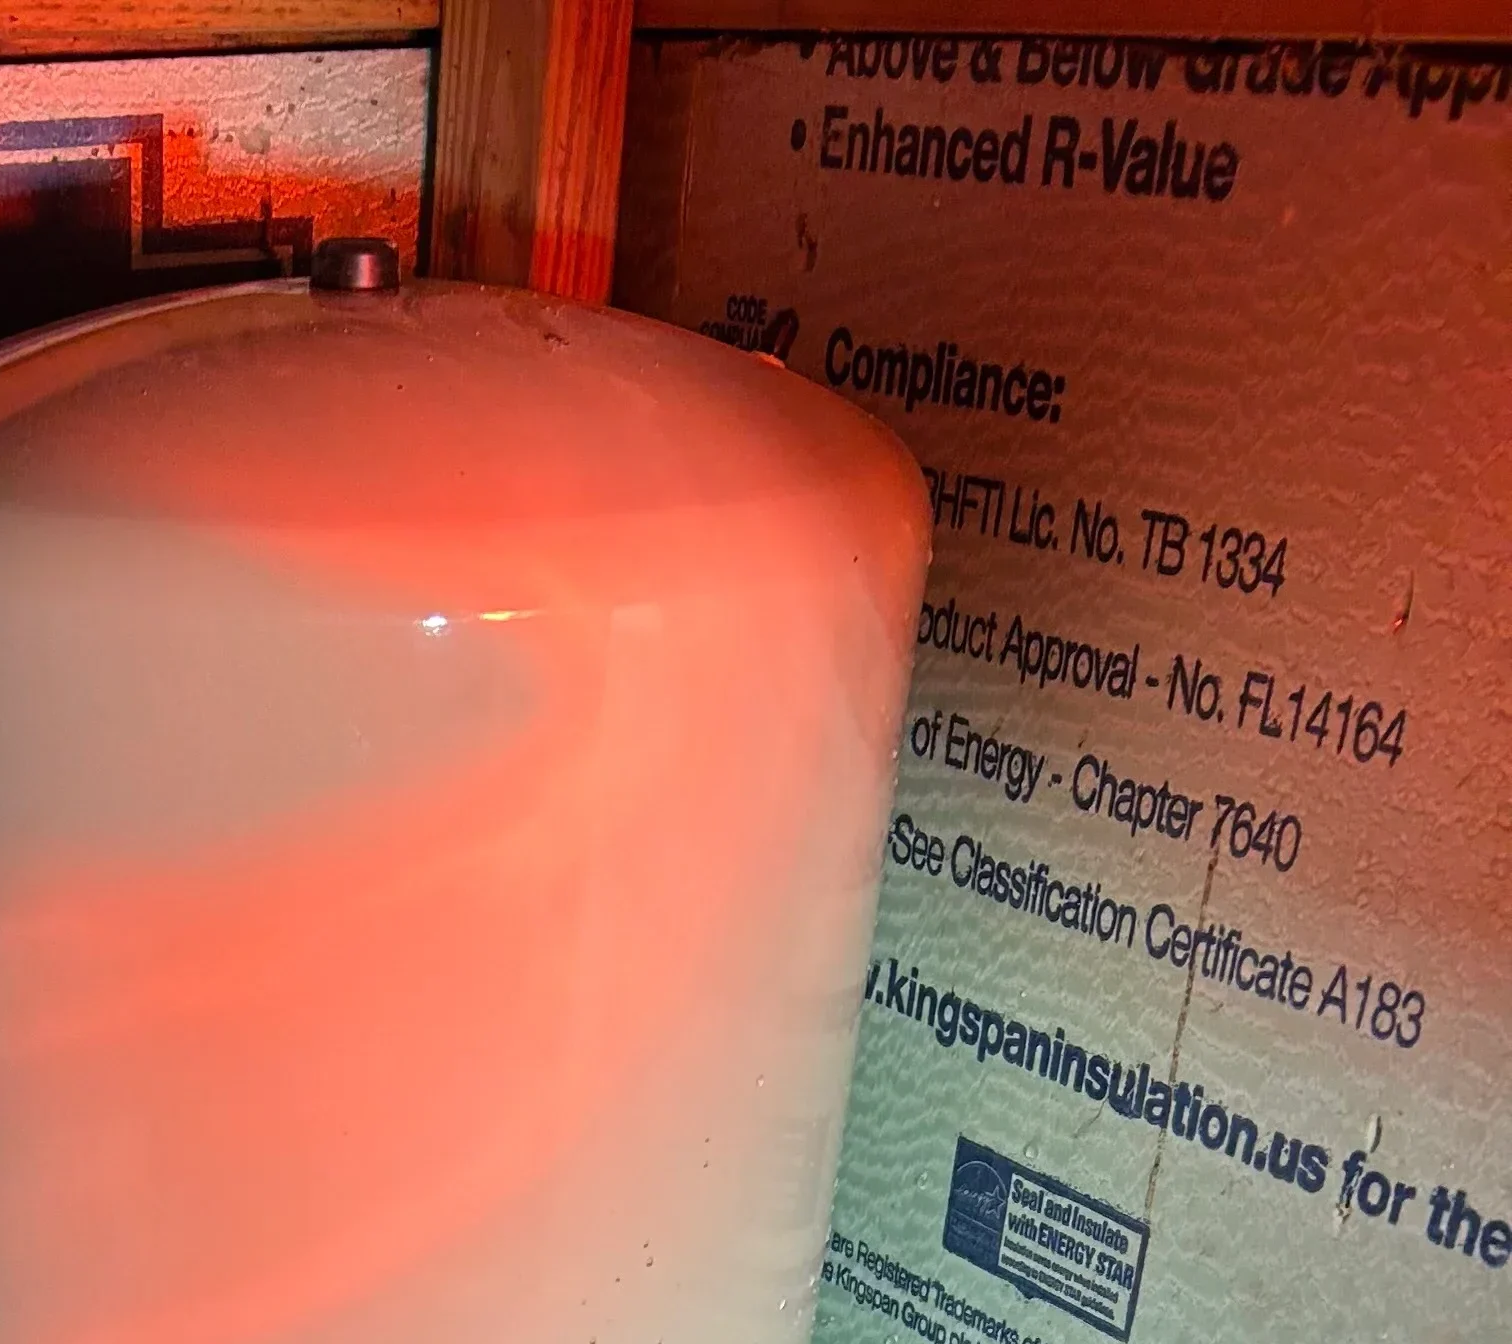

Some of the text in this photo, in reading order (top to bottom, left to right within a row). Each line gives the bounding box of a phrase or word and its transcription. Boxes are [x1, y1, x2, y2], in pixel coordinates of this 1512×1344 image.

[820, 105, 1240, 202] Enhanced R-Value
[727, 294, 769, 326] CODE
[826, 326, 1066, 424] Compliance:
[1010, 486, 1060, 552] Lic.
[1071, 499, 1126, 566] No.
[1142, 508, 1191, 577] TB
[1199, 523, 1288, 597] 1334
[916, 600, 997, 663] oduct
[1000, 612, 1140, 700] Approval
[1168, 654, 1225, 723] No.
[1237, 670, 1409, 768] FL14164
[911, 713, 947, 762] of
[946, 713, 1044, 803] Energy
[1071, 754, 1203, 841] Chapter
[1212, 793, 1303, 873] 7640
[951, 833, 1138, 949] Classification
[1144, 903, 1316, 1011] Certificate
[1317, 964, 1427, 1050] A183
[864, 956, 1512, 1270] .kingspaninsulation.us for the
[1008, 1212, 1037, 1242] with
[1038, 1222, 1096, 1269] ENERGY
[1095, 1254, 1136, 1290] STAR
[1011, 1178, 1044, 1214] Seal
[1046, 1198, 1071, 1228] and
[1073, 1208, 1130, 1256] Insulate
[835, 1266, 900, 1320] Kingspan
[856, 1240, 931, 1303] Registered
